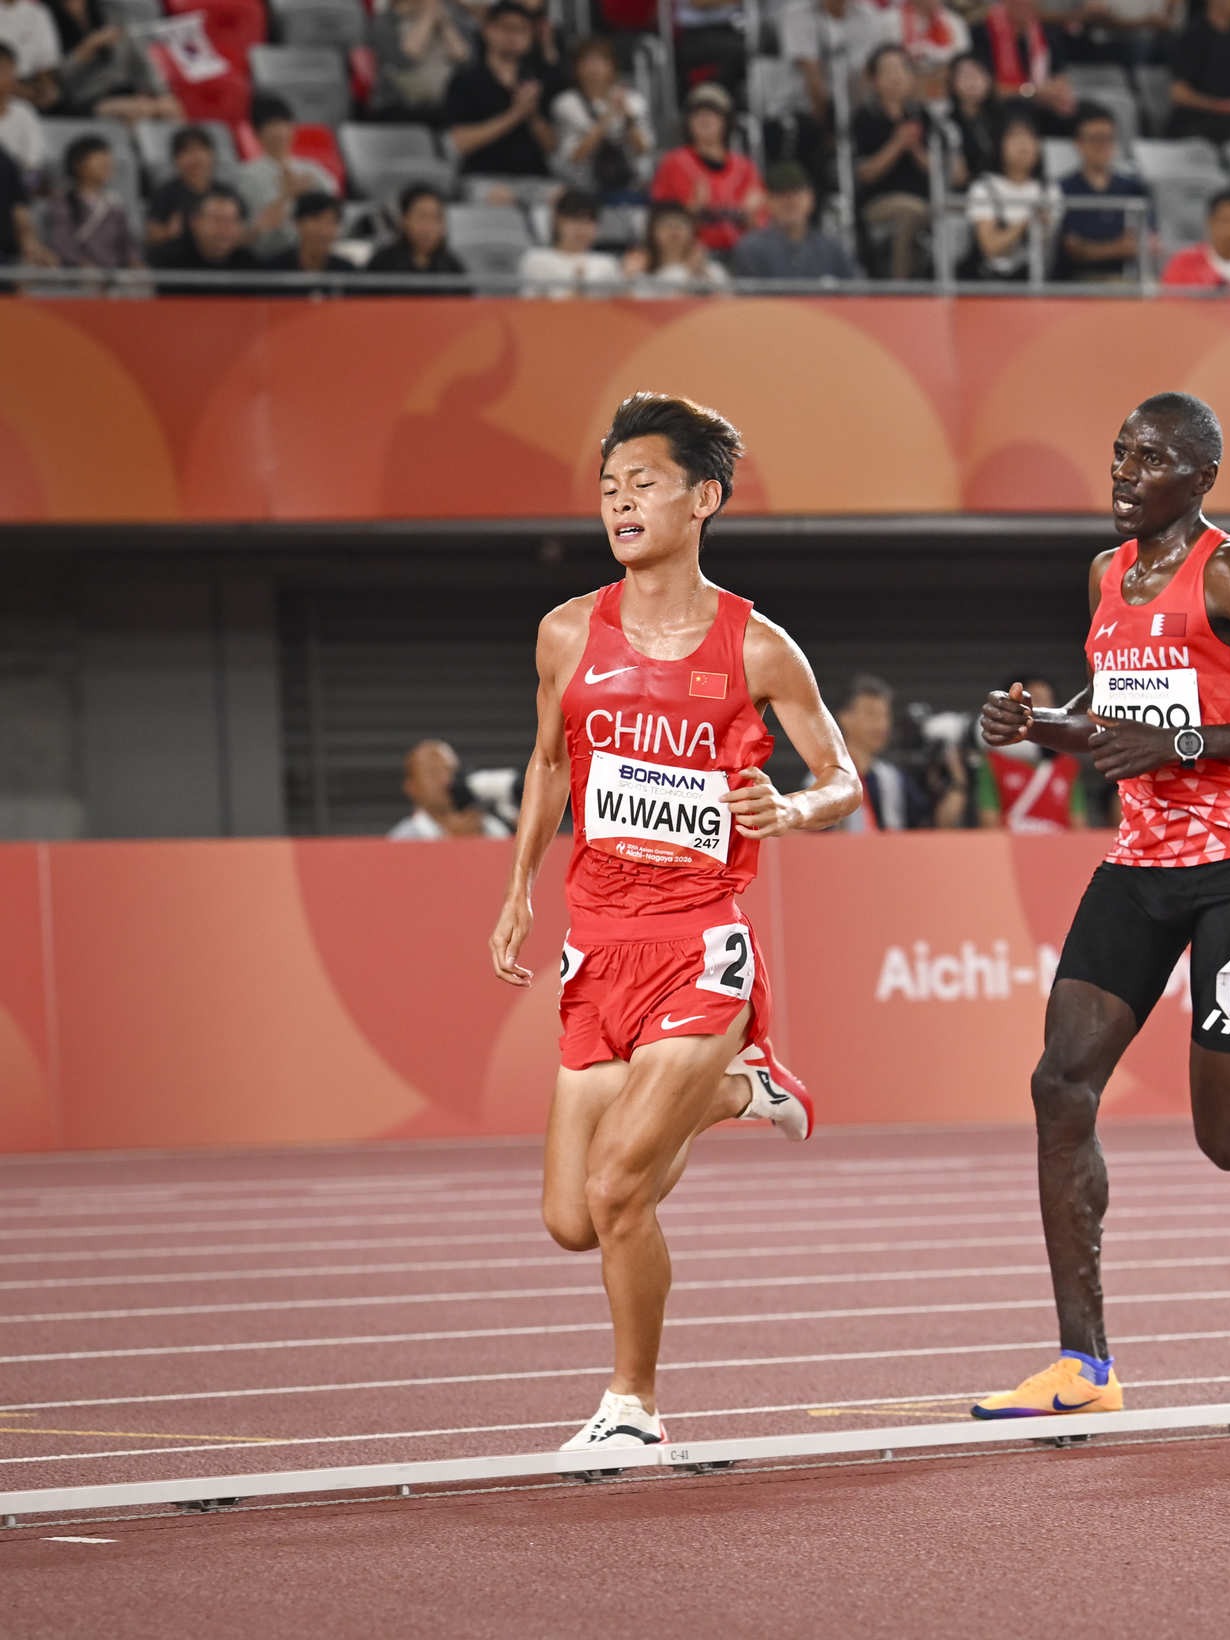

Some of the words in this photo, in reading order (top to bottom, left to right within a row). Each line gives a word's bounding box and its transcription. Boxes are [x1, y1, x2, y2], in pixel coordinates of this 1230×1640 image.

[1093, 646, 1190, 671] BAHRAIN
[1108, 677, 1169, 690] BORNAN
[585, 709, 717, 759] CHINA
[619, 764, 705, 791] BORNAN
[596, 788, 721, 836] W.WANG
[693, 838, 720, 849] 247
[720, 932, 748, 989] 2
[670, 1449, 689, 1460] C-41
